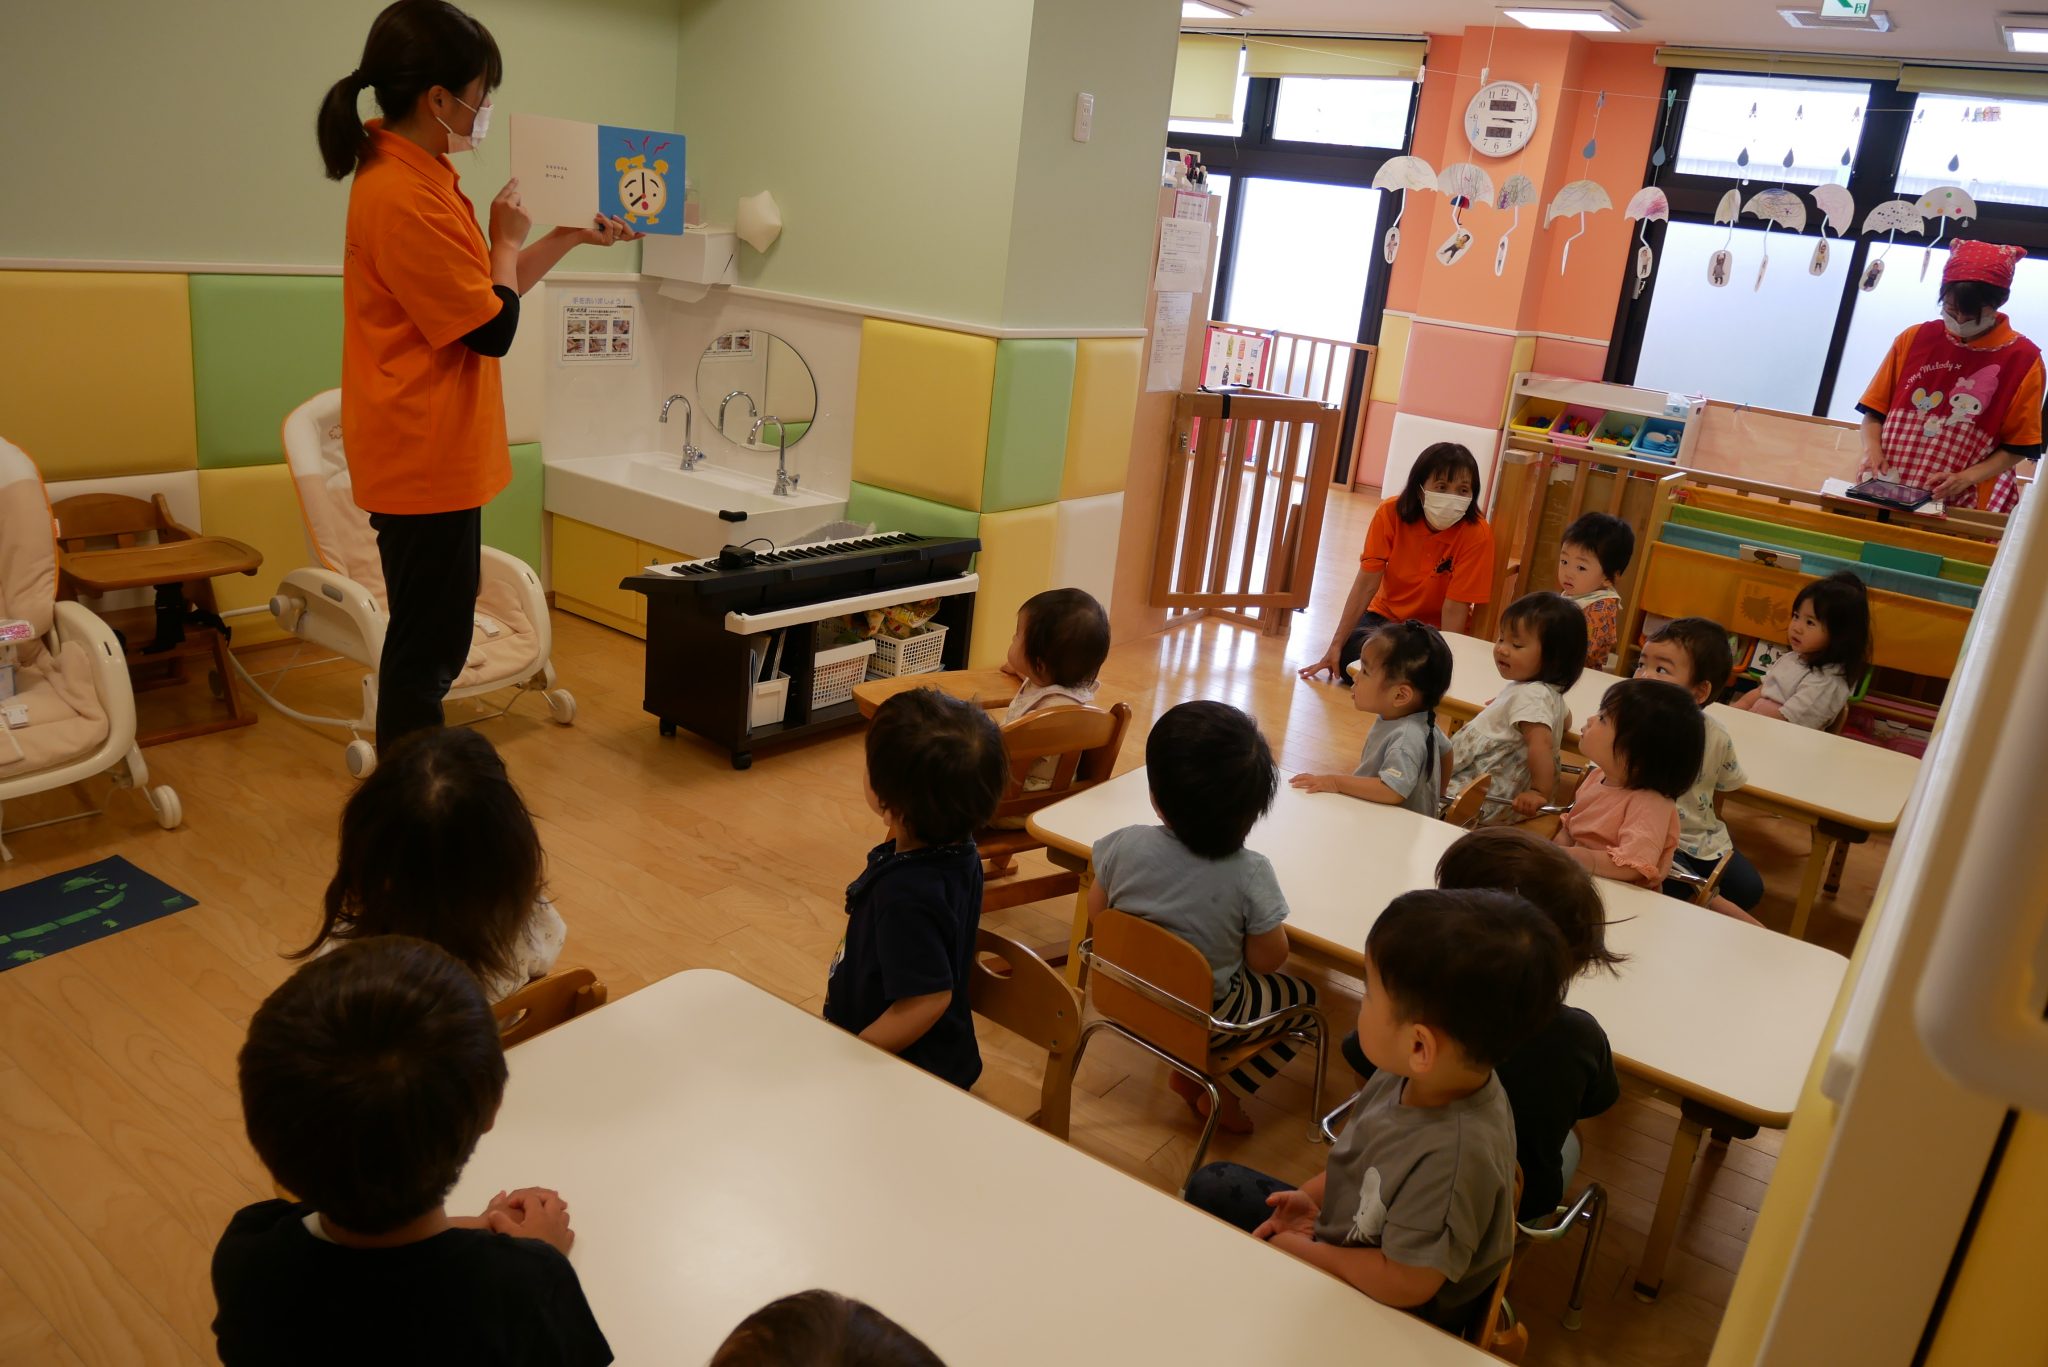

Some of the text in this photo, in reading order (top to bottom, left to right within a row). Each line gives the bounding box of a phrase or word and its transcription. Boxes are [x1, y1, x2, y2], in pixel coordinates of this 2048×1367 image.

[1489, 91, 1496, 100] 11
[1500, 88, 1509, 97] 12
[1479, 101, 1486, 109] 10
[1523, 103, 1529, 111] 2
[1523, 117, 1530, 125] 3
[1517, 131, 1523, 139] 4
[1484, 138, 1489, 147] 7
[1507, 139, 1513, 148] 5
[1908, 360, 1953, 383] My Melody
